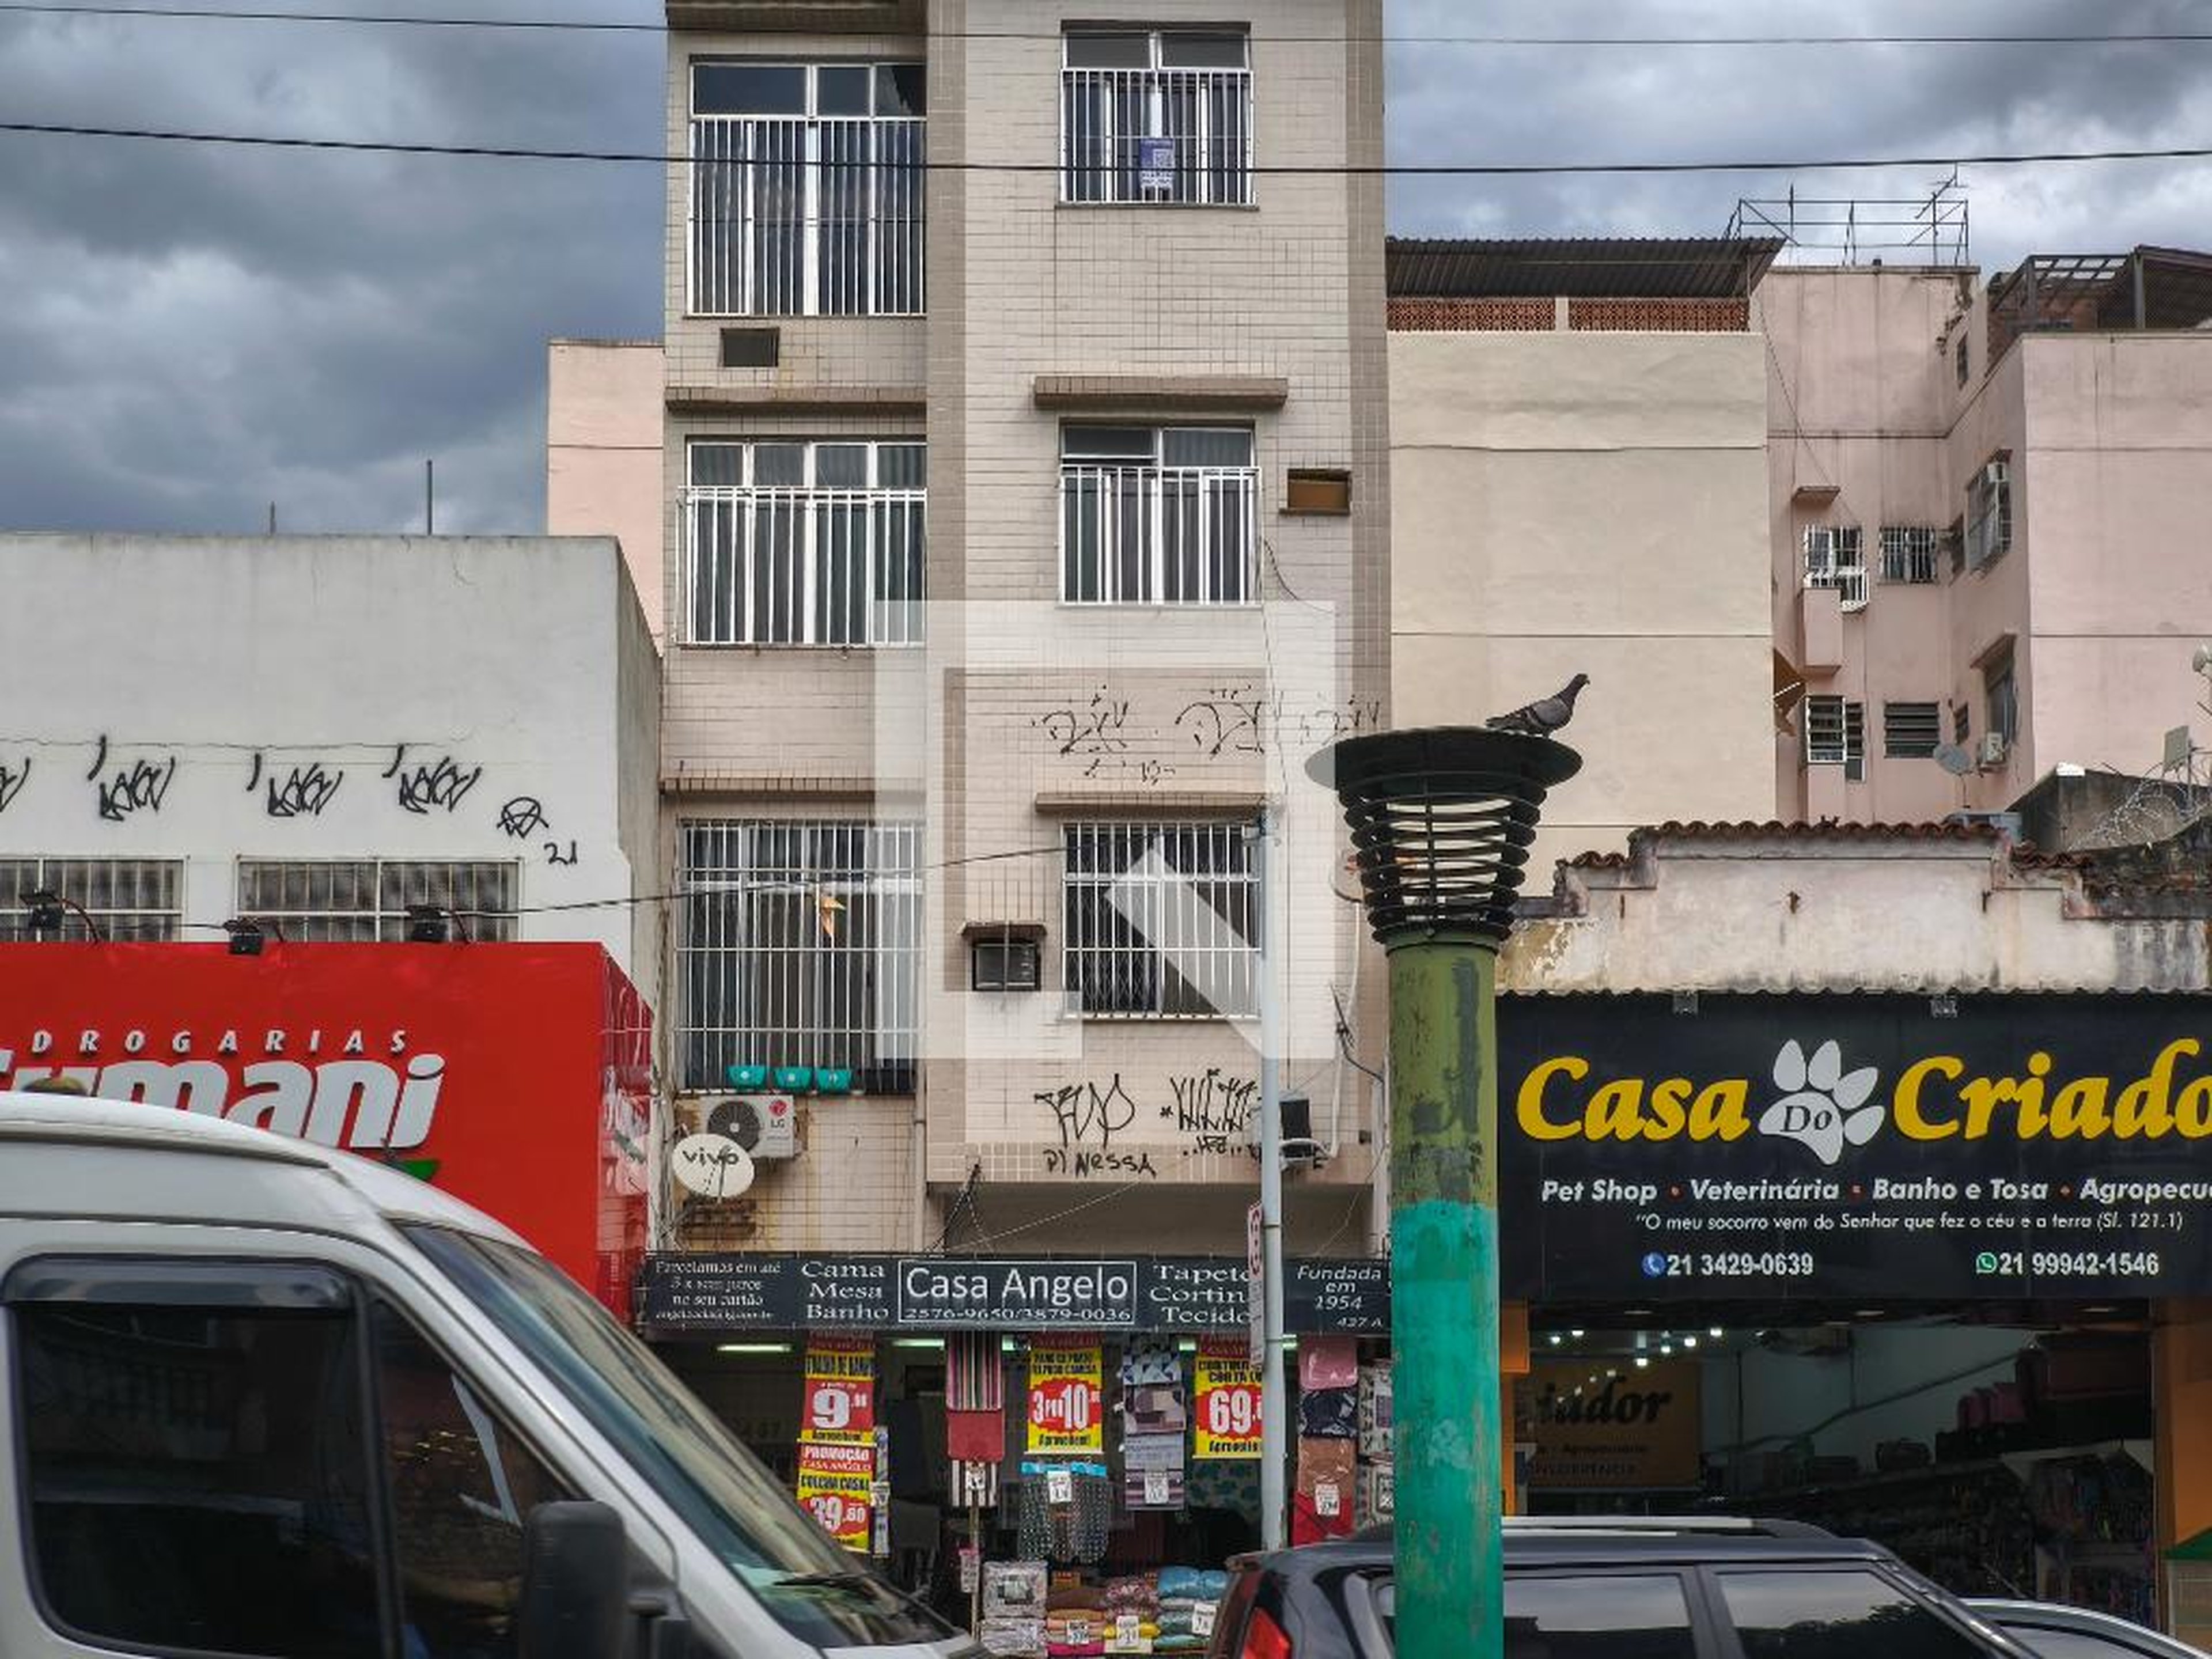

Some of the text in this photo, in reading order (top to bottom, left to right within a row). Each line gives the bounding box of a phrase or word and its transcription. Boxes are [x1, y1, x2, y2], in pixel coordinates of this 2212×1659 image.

[32, 1030, 407, 1054] DROGARIAS
[1516, 1056, 1751, 1141] Casa
[1780, 1105, 1832, 1132] Do
[1542, 1180, 1585, 1202] Pet
[1592, 1179, 1657, 1205] Shop
[1691, 1178, 1840, 1200] Veterinária
[1872, 1177, 1957, 1200] Banho
[1965, 1183, 1982, 1199] e
[1990, 1178, 2048, 1200] Tosa
[1667, 1218, 1702, 1230] meu
[1708, 1218, 1767, 1230] socorro
[1773, 1218, 1807, 1230] vem
[1814, 1214, 1833, 1230] do
[1840, 1213, 1899, 1229] Senhor
[1904, 1217, 1935, 1231] que
[1940, 1213, 1964, 1228] fez
[1970, 1218, 1980, 1228] o
[1987, 1214, 2014, 1228] céu
[2021, 1218, 2029, 1228] e
[2036, 1218, 2046, 1228] a
[2052, 1214, 2092, 1228] terra
[801, 1261, 886, 1277] Cama
[1667, 1253, 1813, 1275] 21 3429-0639
[1999, 1252, 2159, 1275] 21 99942-1546
[1297, 1266, 1381, 1280] Fundada
[809, 1283, 882, 1298] Mesa
[906, 1266, 1128, 1306] Casa Angelo
[1325, 1282, 1355, 1293] em
[1150, 1287, 1246, 1303] Cortin
[1315, 1296, 1362, 1310] 1954
[807, 1302, 889, 1319] Banho
[1161, 1306, 1249, 1323] Tecido
